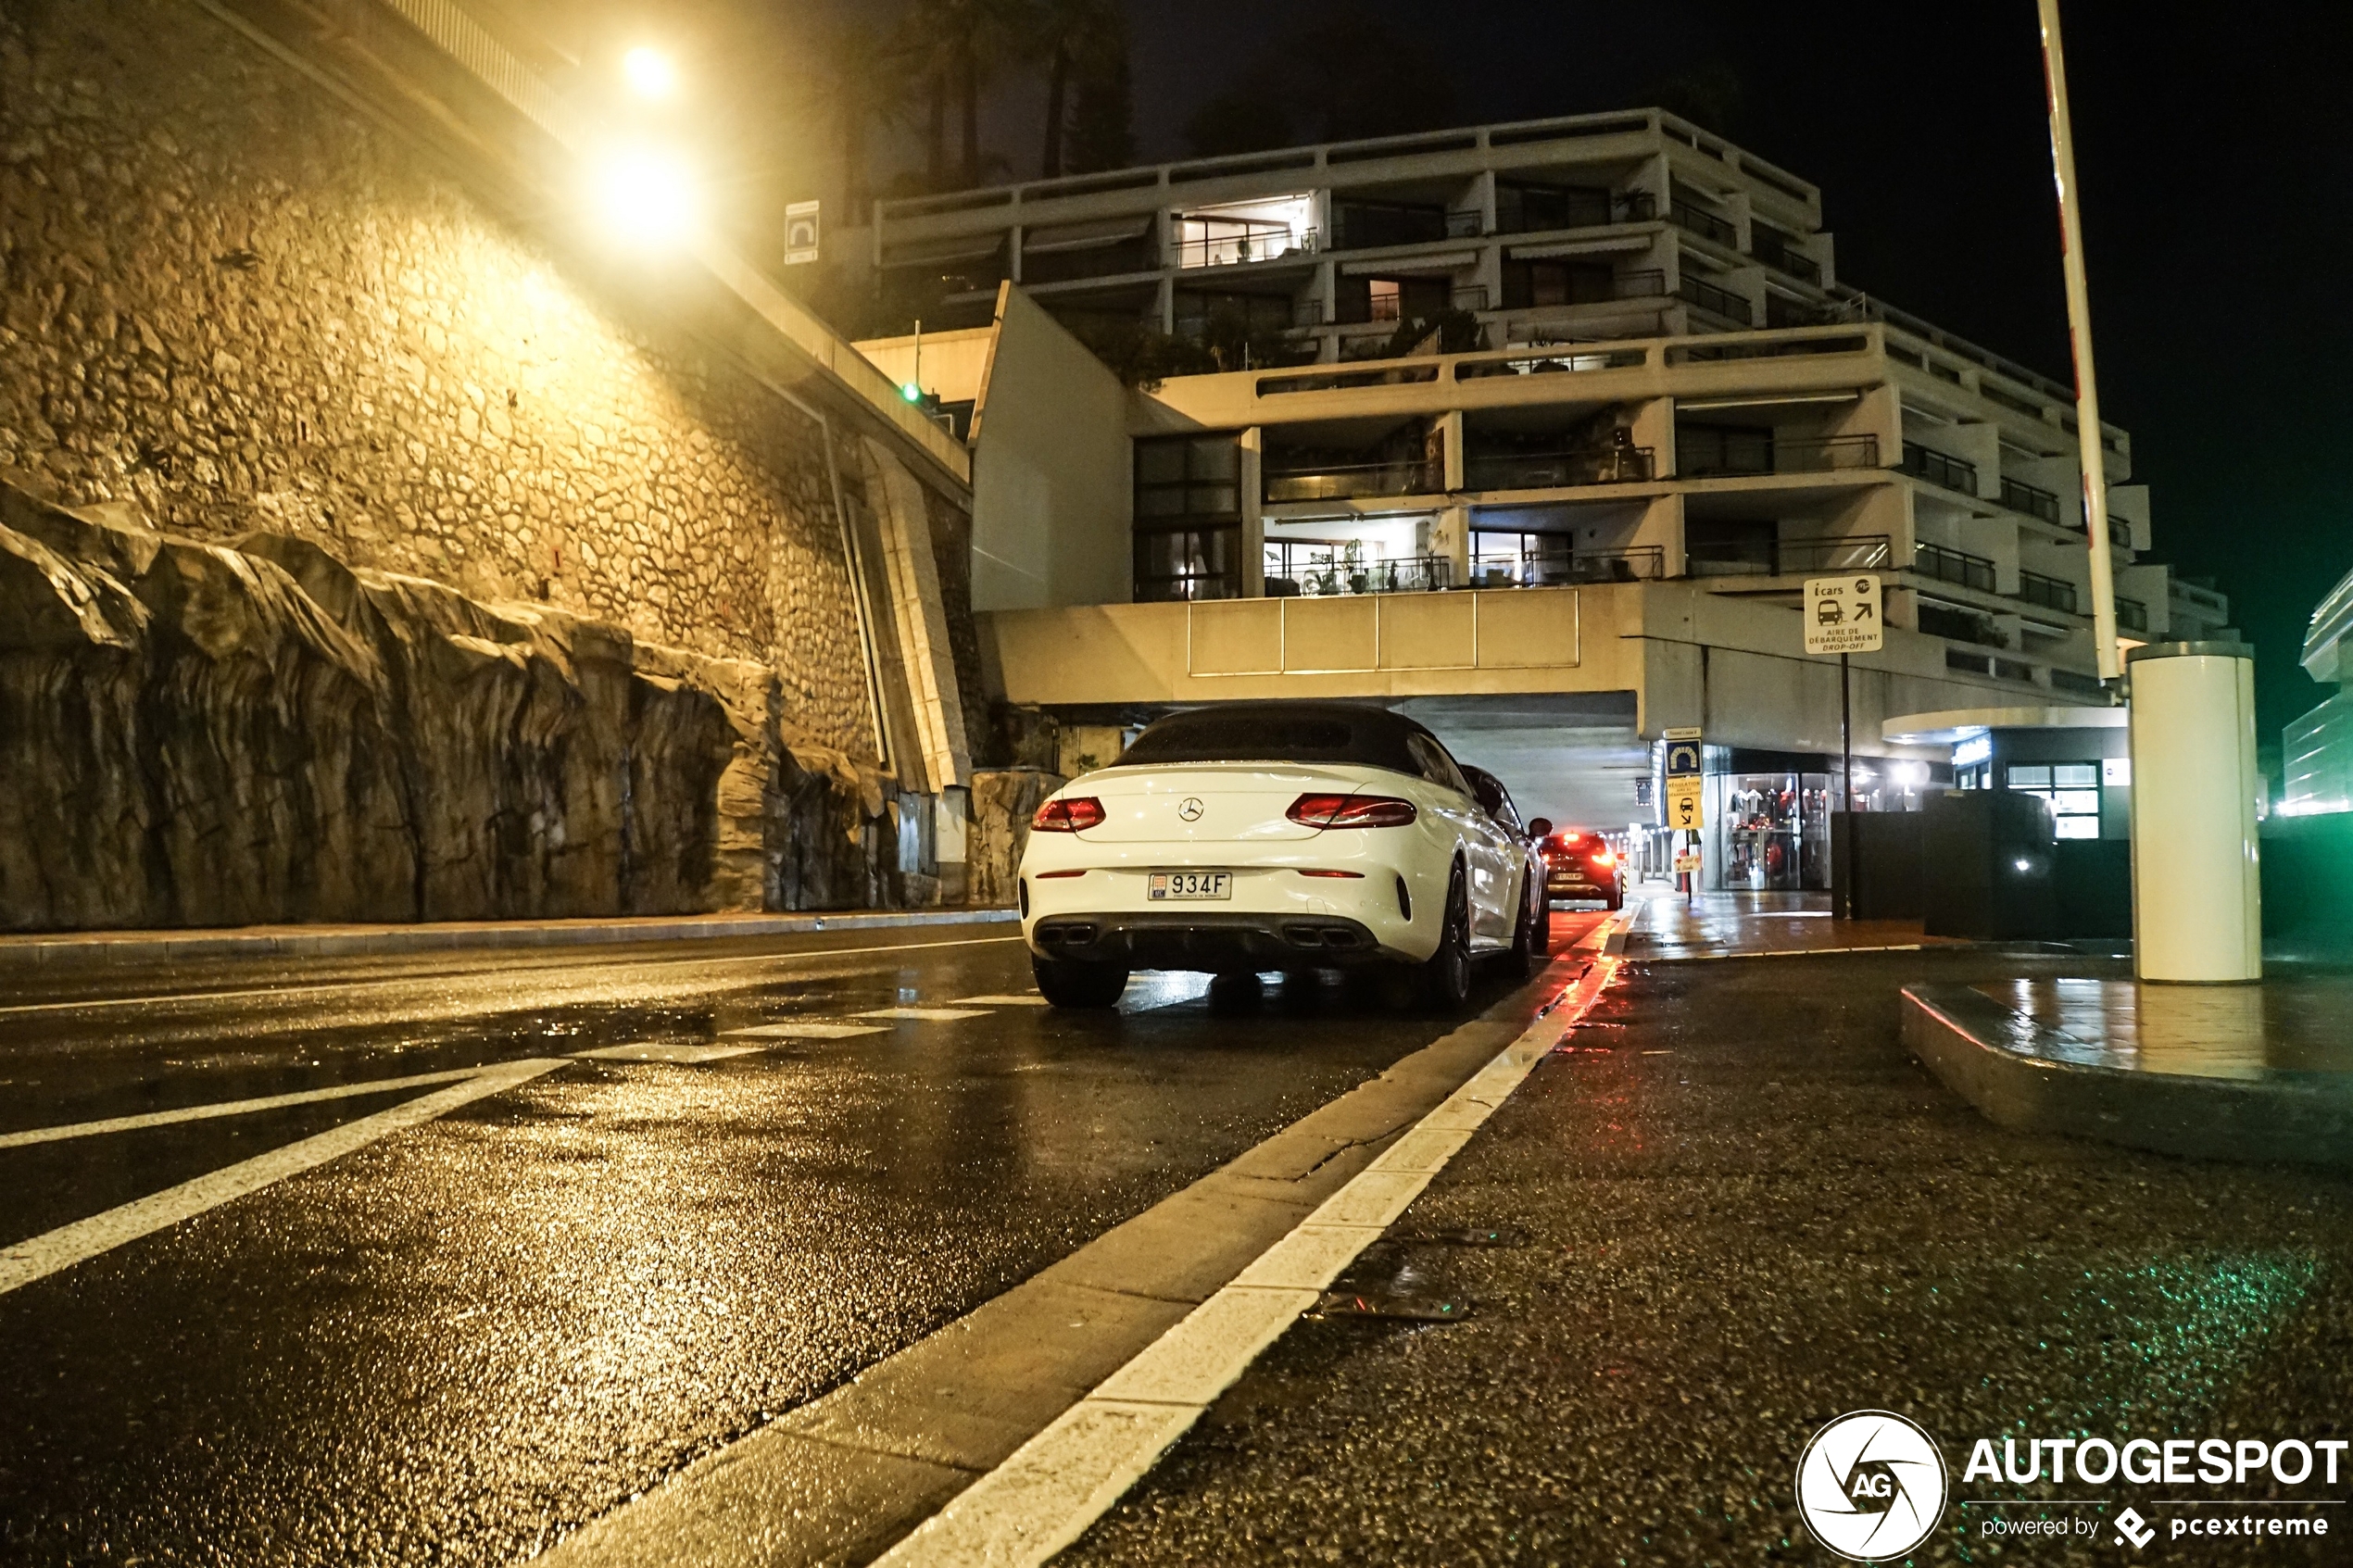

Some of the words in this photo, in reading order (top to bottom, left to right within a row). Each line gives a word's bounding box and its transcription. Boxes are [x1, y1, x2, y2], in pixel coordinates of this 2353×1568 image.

[1809, 633, 1878, 644] DÉBARQUEMENT
[1822, 643, 1865, 651] DROP-OFF
[1172, 875, 1226, 893] 934F
